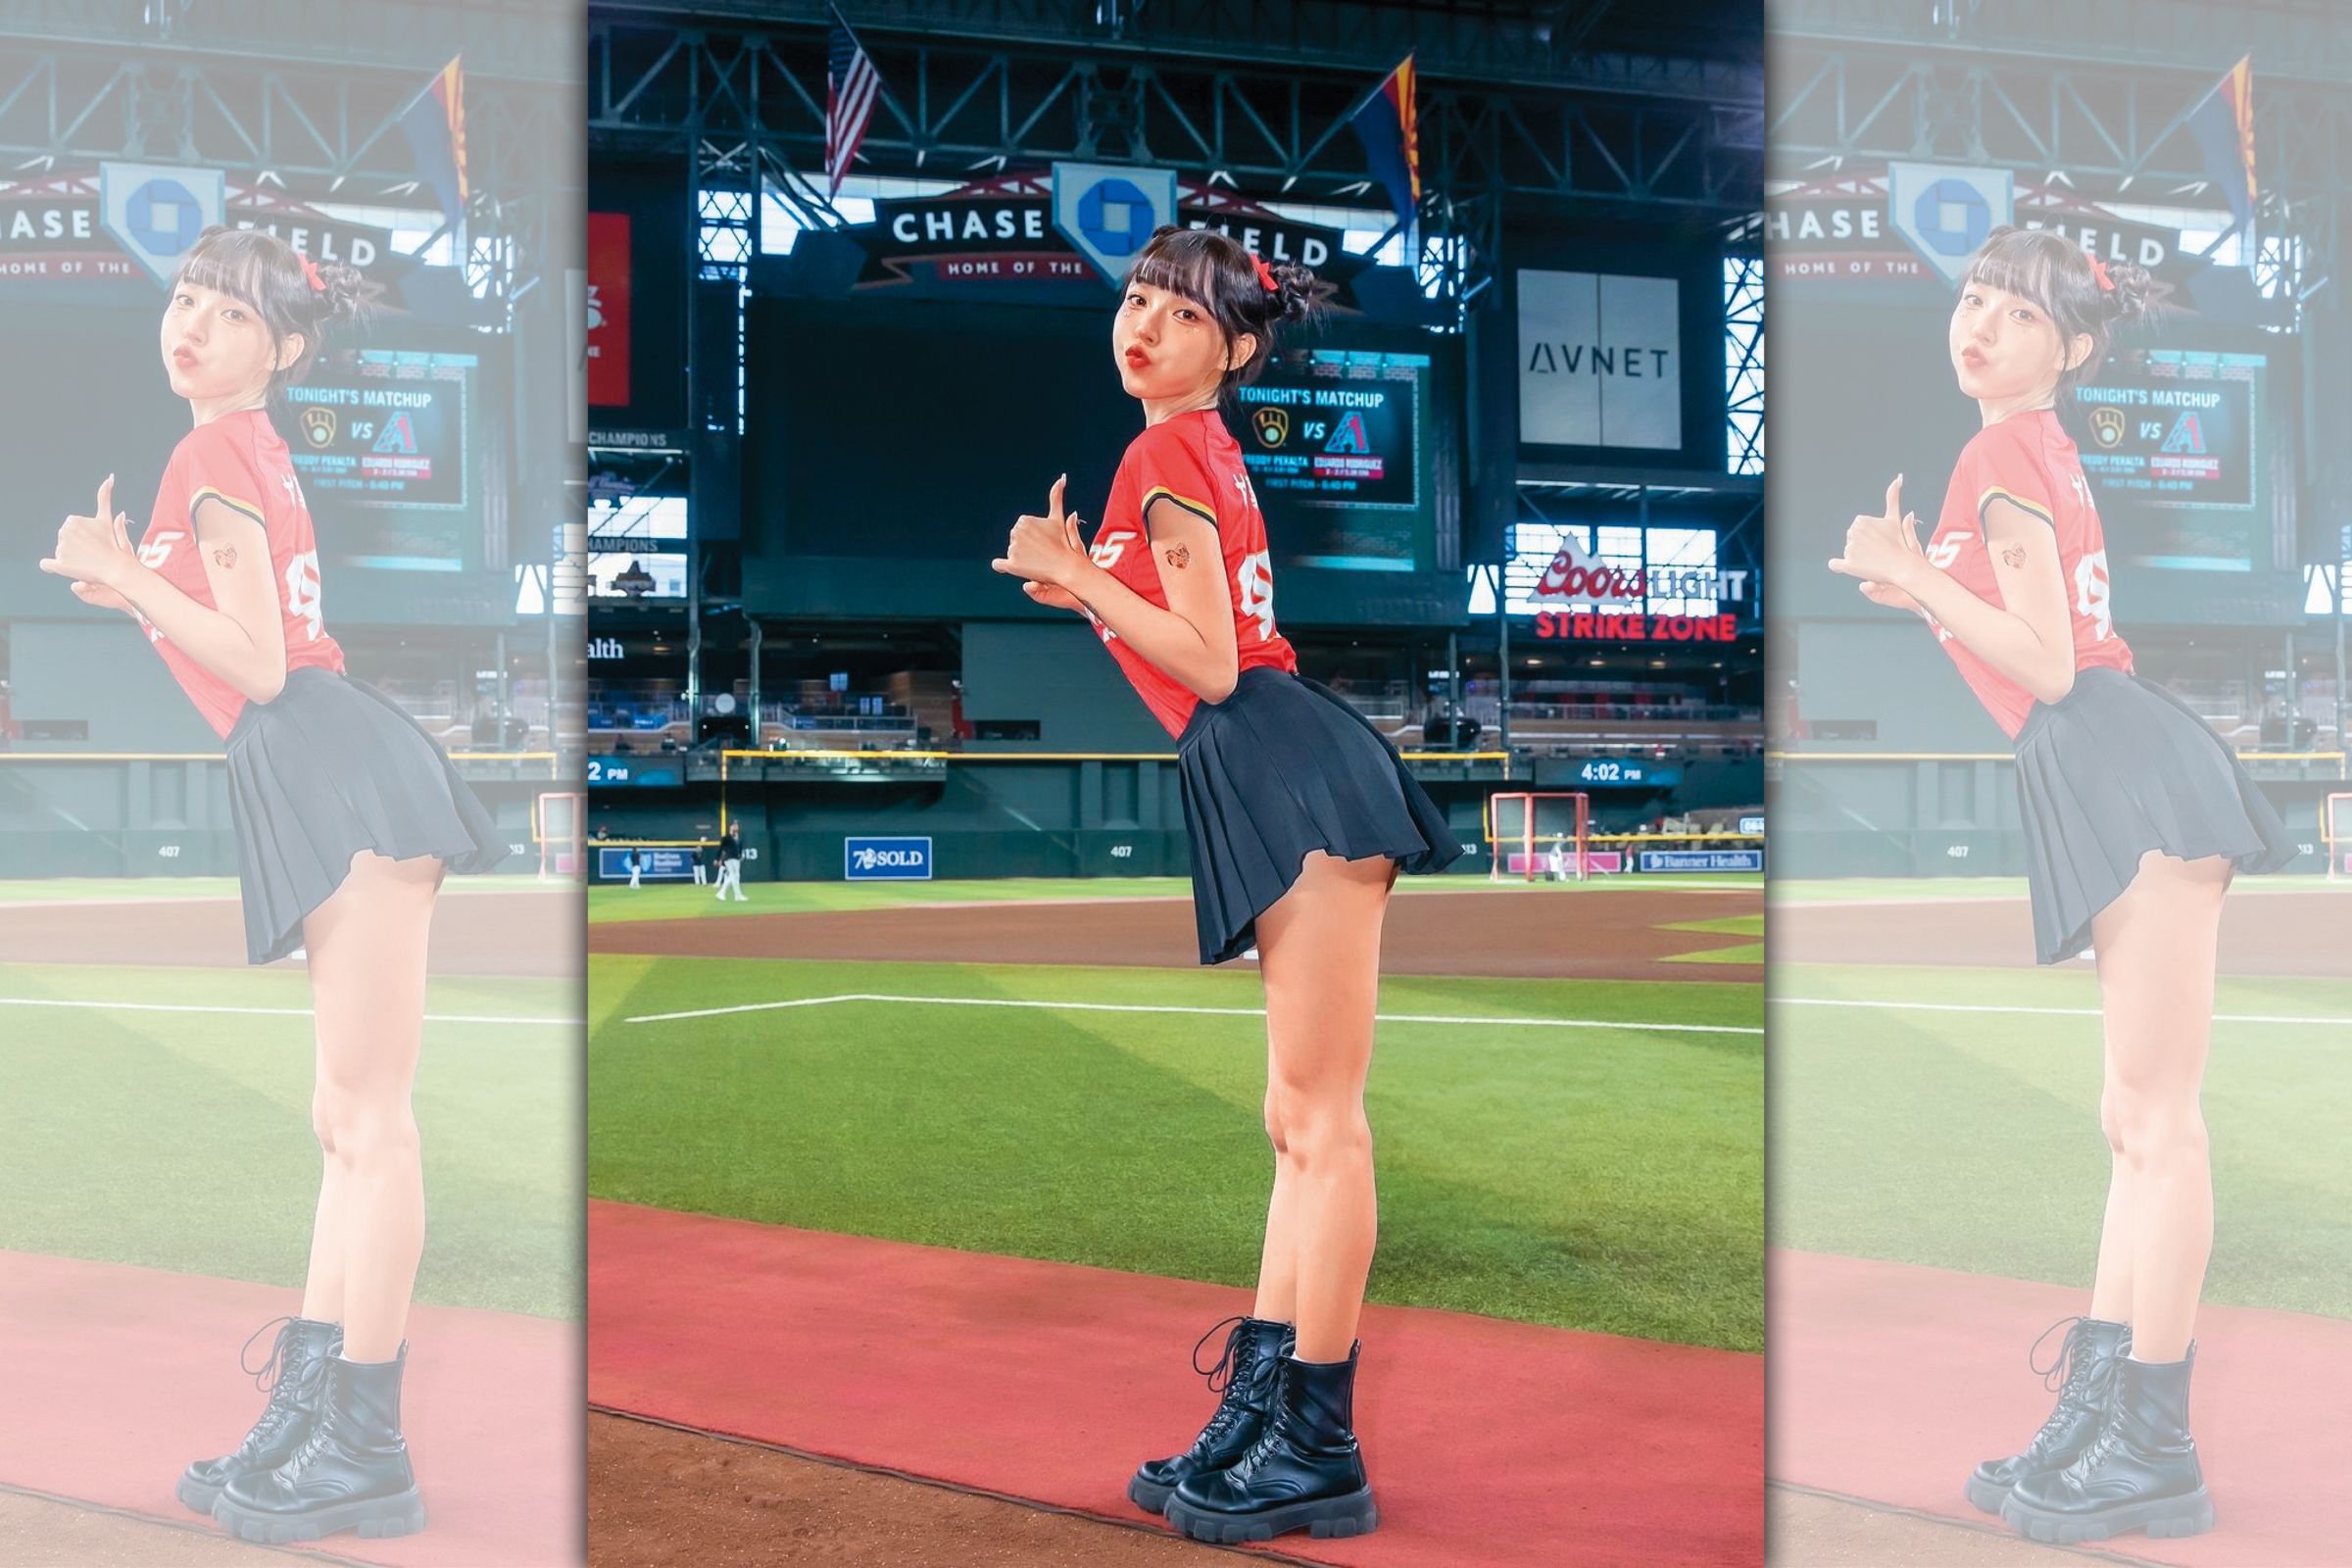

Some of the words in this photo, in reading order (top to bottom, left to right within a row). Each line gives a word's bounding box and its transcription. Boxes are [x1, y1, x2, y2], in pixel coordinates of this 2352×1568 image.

[0, 209, 91, 239] ASE
[236, 220, 375, 267] ELD
[893, 209, 1044, 242] CHASE
[1189, 220, 1328, 267] ELD
[2026, 220, 2165, 267] ELD
[61, 261, 82, 274] OF
[96, 262, 129, 274] THE
[948, 262, 1000, 274] HOME
[1013, 261, 1035, 274] OF
[1049, 262, 1082, 274] THE
[1785, 262, 1837, 274] HOME
[1850, 261, 1872, 274] OF
[1886, 262, 1919, 274] THE
[1529, 342, 1669, 378] AVNET
[286, 387, 359, 405] TONIGHT'S
[363, 391, 431, 408] MATCHUP
[1239, 387, 1311, 405] TONIGHT'S
[1315, 391, 1384, 408] MATCHUP
[2076, 387, 2148, 405] TONIGHT'S
[2152, 391, 2221, 408] MATCHUP
[351, 421, 373, 439] VS
[588, 431, 667, 446] CHAMPIONS
[1303, 421, 1326, 439] VS
[2140, 421, 2163, 439] VS
[1536, 550, 1646, 598] Coors
[1651, 570, 1747, 601] LIGHT
[1536, 612, 1646, 640] STRIKE
[1651, 613, 1737, 642] ZONE
[588, 638, 624, 659] alth
[607, 768, 628, 780] PM
[1581, 763, 1619, 781] 4:02
[1624, 769, 1642, 780] PM
[158, 846, 179, 858] 407
[510, 844, 524, 856] 13
[742, 848, 759, 859] 13
[1110, 846, 1132, 858] 407
[1462, 844, 1477, 856] 13
[1947, 846, 1969, 858] 407
[2299, 844, 2314, 856] 13
